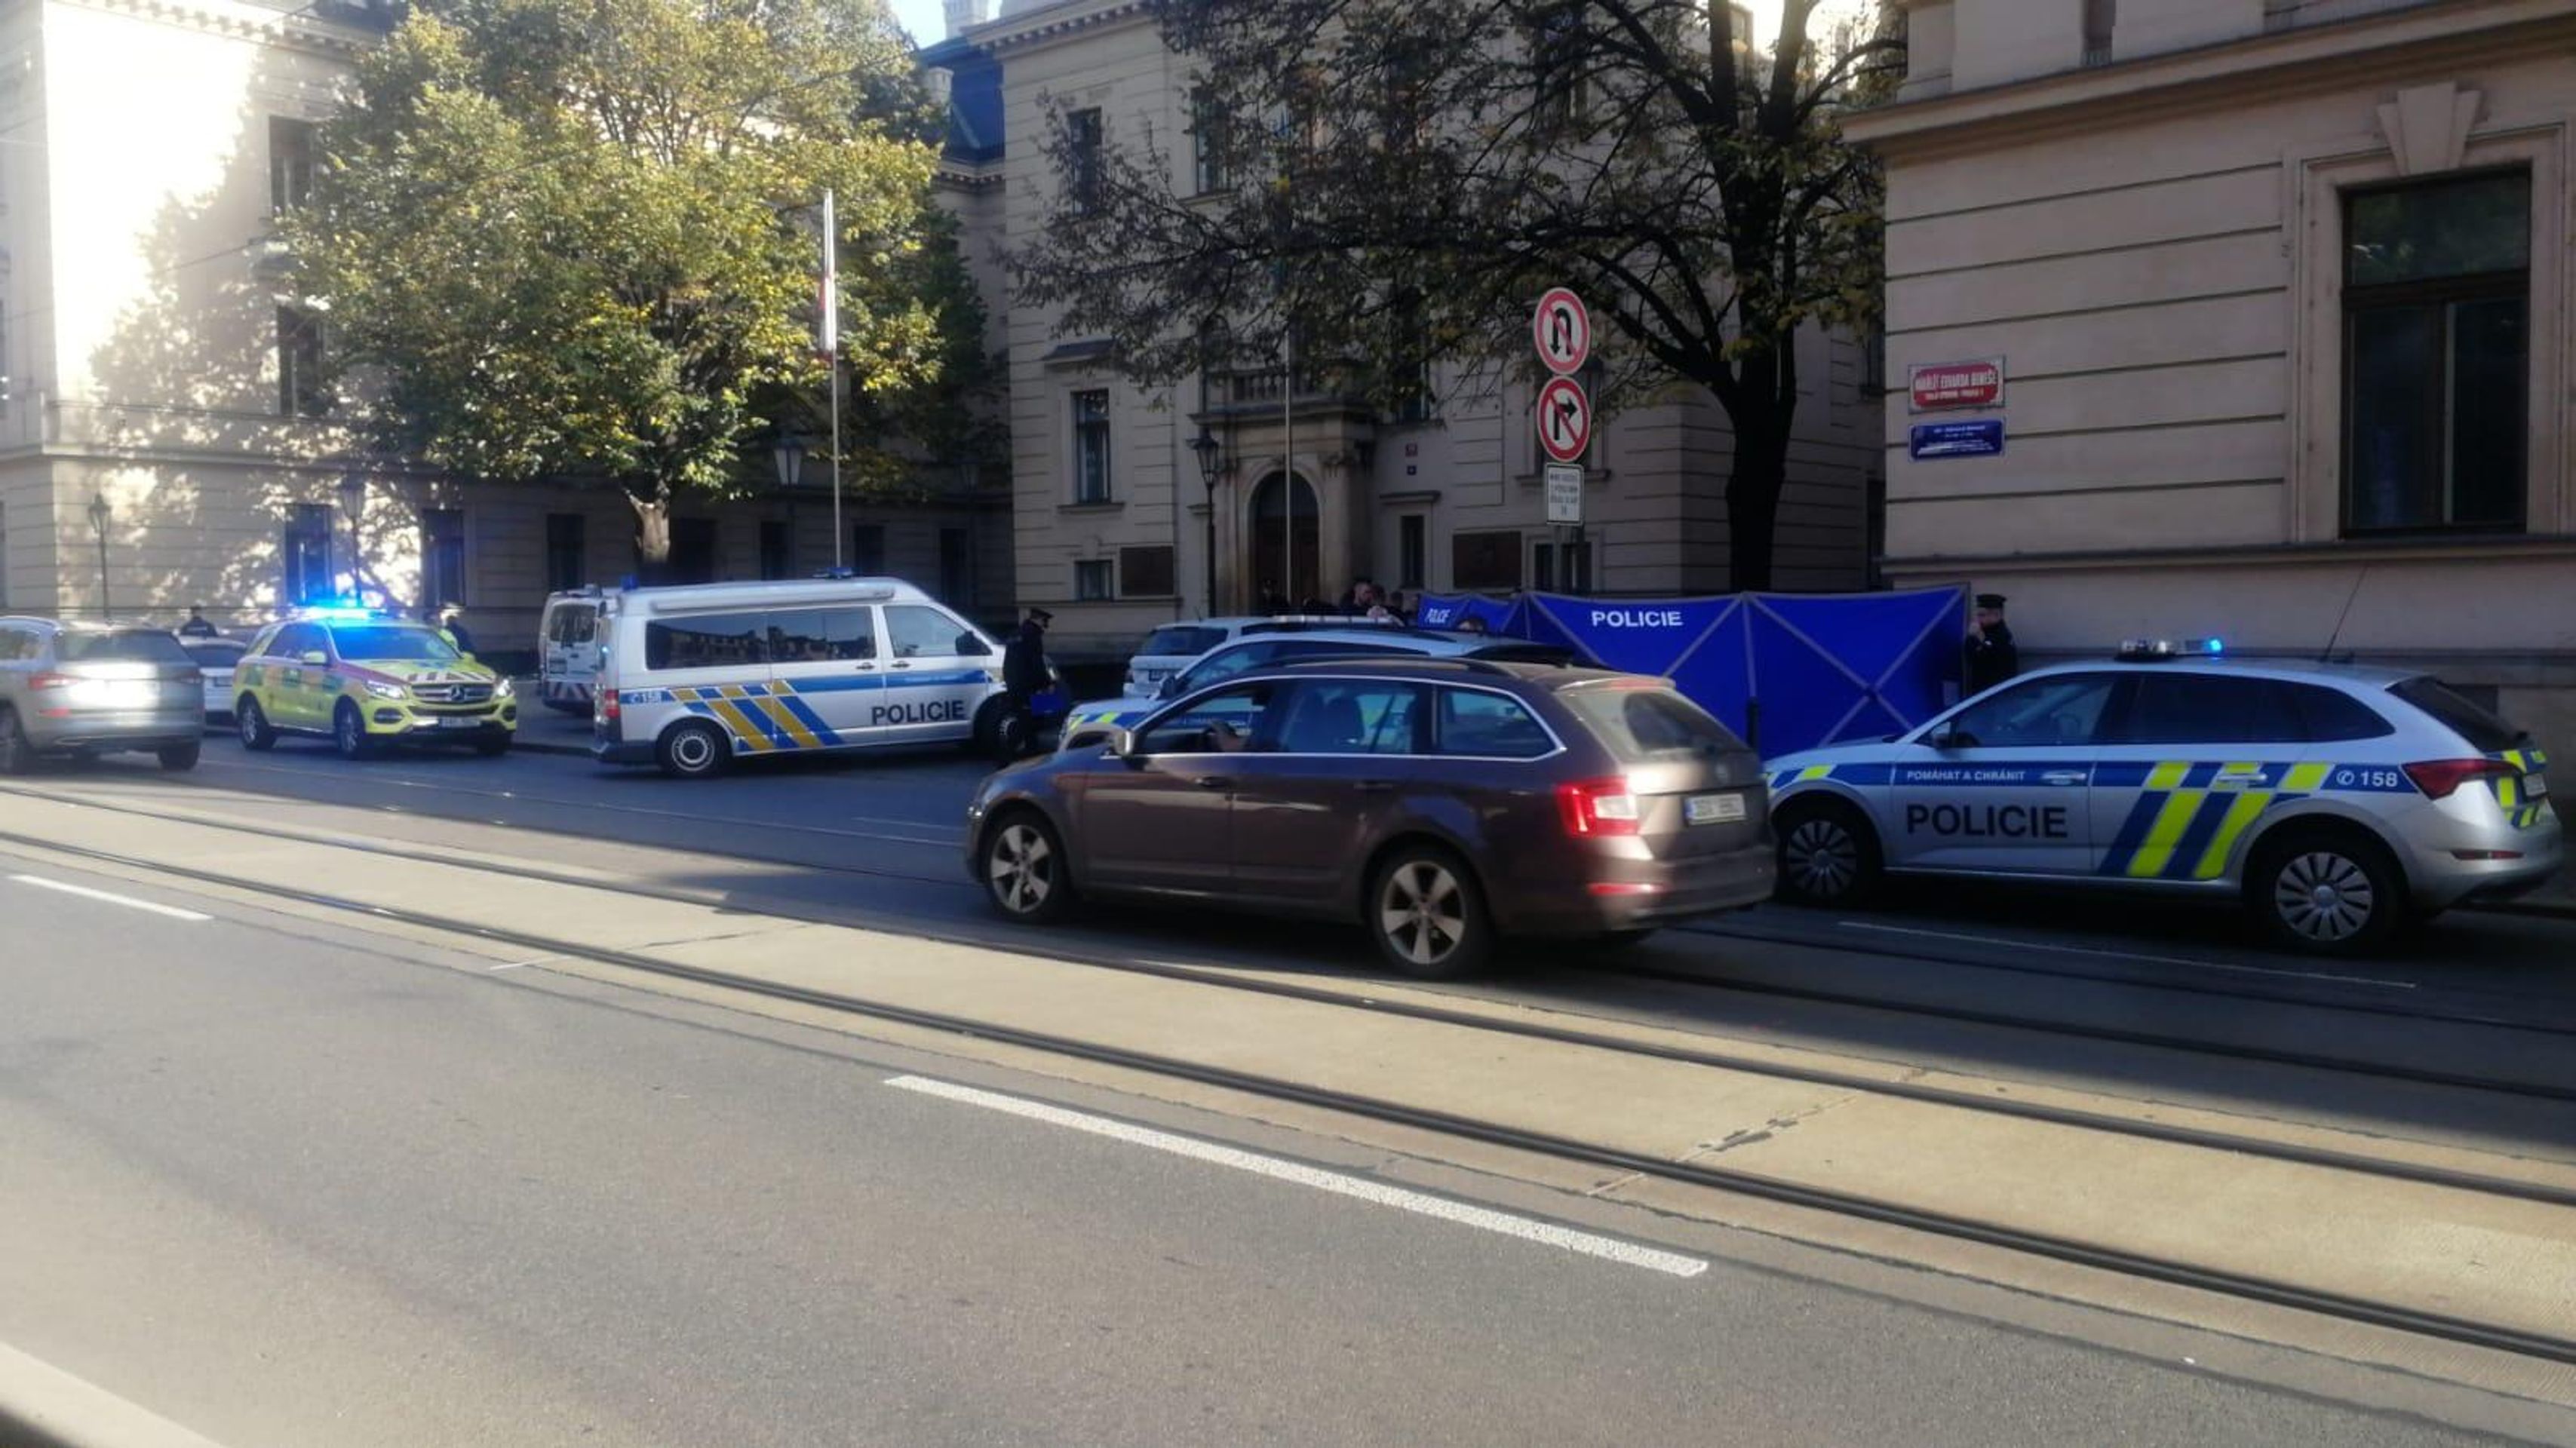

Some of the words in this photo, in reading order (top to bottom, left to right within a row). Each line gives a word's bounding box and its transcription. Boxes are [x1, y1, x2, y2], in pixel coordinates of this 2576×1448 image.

[1591, 610, 1684, 627] POLICIE
[871, 700, 966, 725] POLICIE
[1907, 768, 1960, 781] POMÁHAT
[1963, 770, 1972, 780] A
[2360, 771, 2398, 787] 158
[1906, 803, 2068, 838] POLICIE
